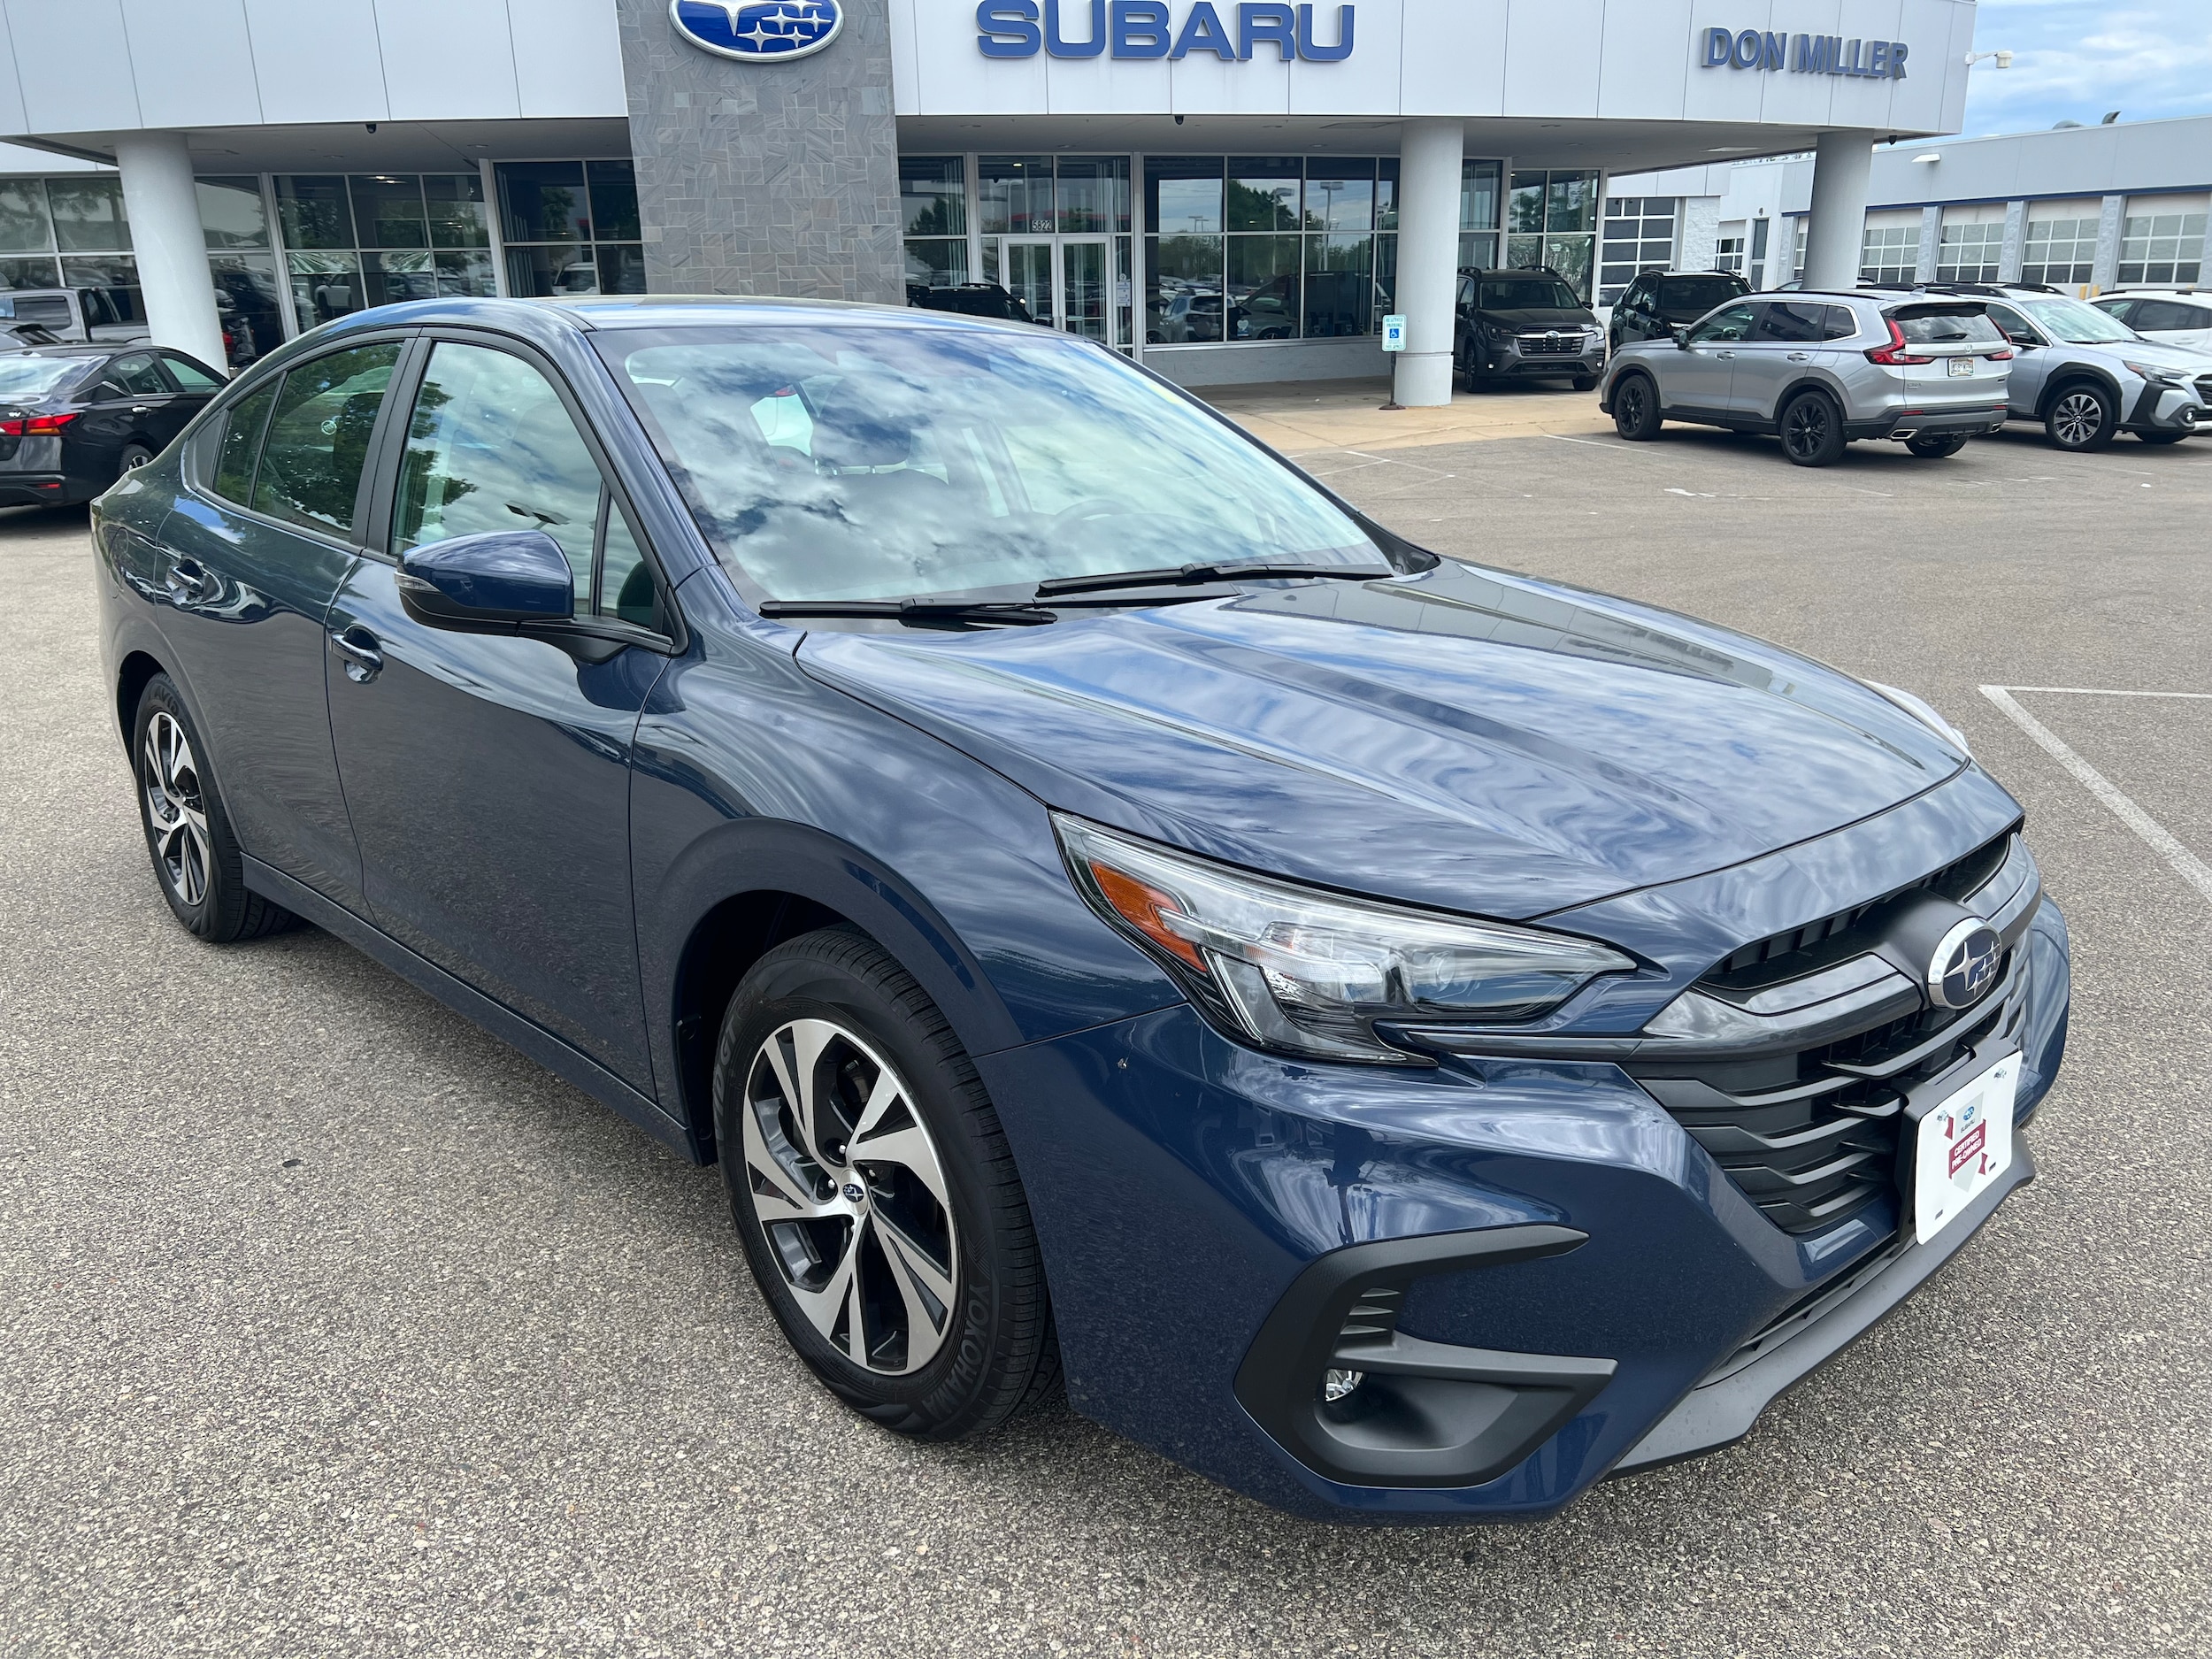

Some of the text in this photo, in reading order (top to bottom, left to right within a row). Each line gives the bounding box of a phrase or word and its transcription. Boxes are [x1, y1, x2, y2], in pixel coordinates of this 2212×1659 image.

[976, 0, 1355, 61] SUBARU
[1701, 27, 1909, 78] DON MILLER
[1032, 220, 1052, 231] 5822
[1951, 1138, 1982, 1170] PRE-OWNED
[1954, 1130, 1979, 1157] CERTIFIED
[921, 1283, 990, 1421] YOKOHAMA
